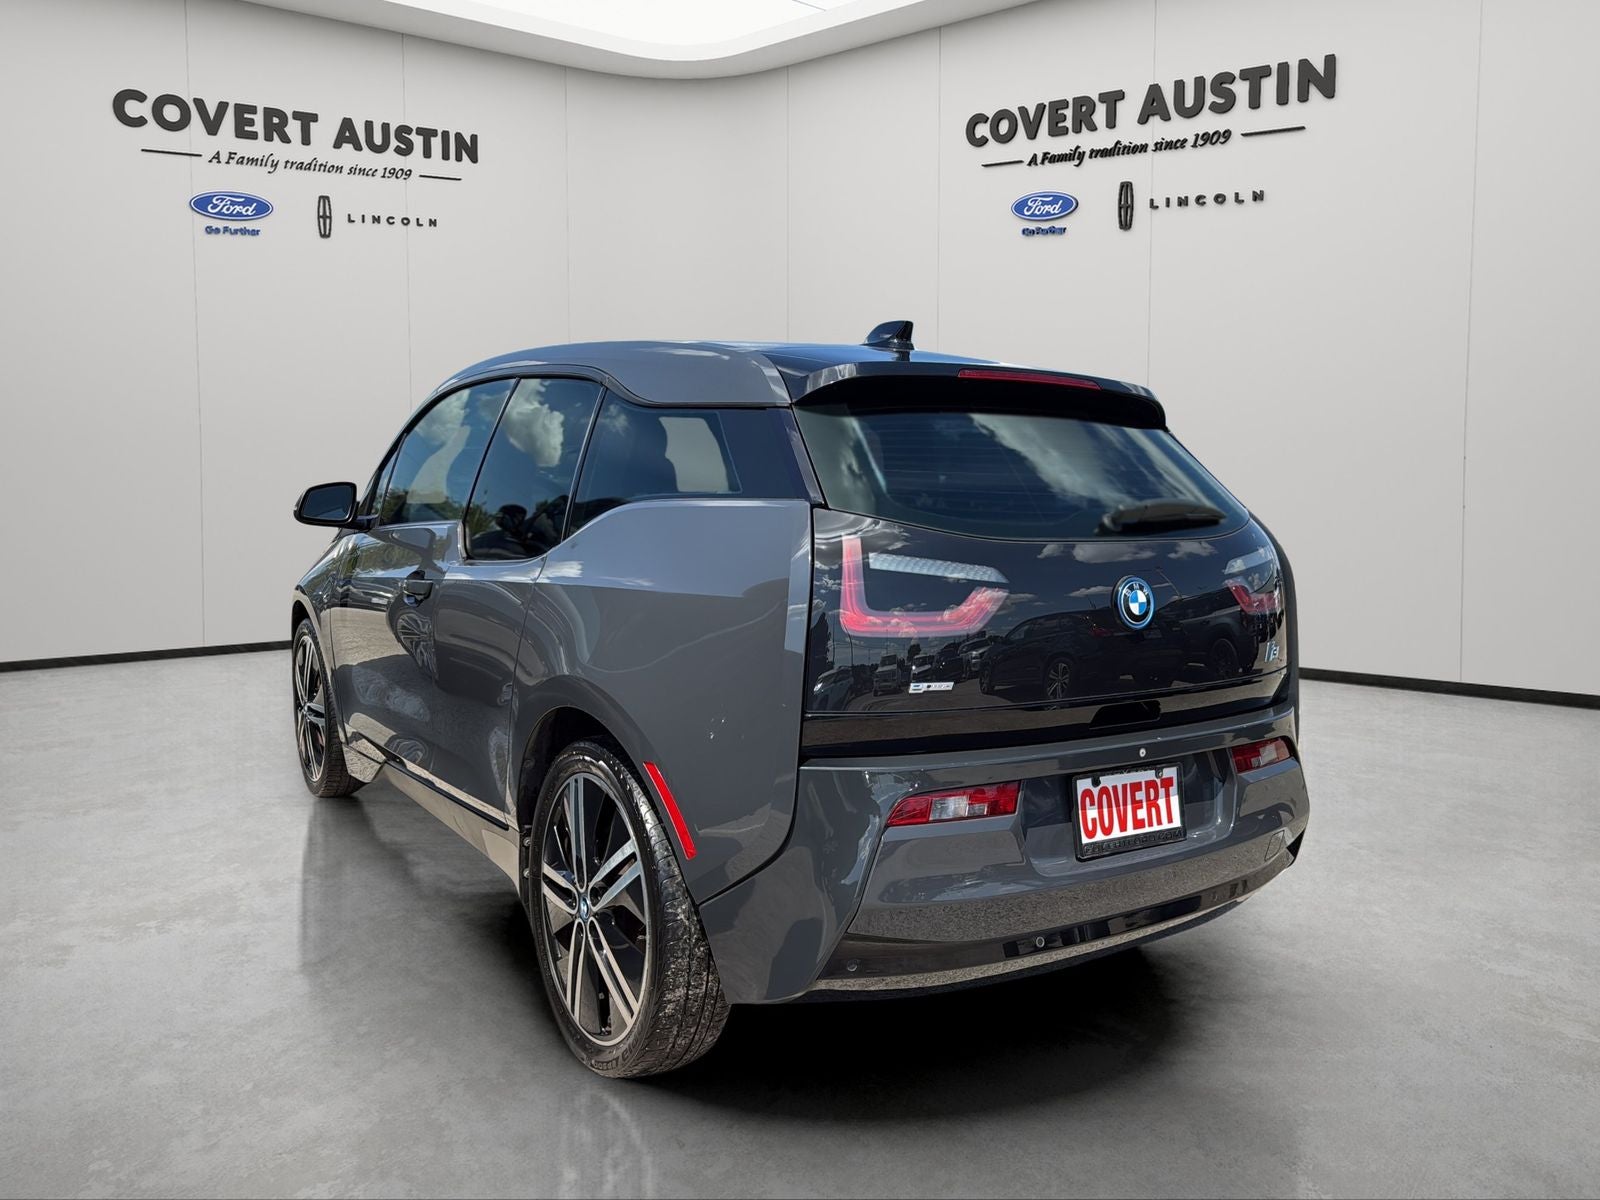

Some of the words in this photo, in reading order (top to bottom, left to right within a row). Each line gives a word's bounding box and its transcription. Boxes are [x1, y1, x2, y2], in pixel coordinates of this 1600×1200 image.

[965, 89, 1126, 148] COVERT
[1136, 53, 1337, 125] AUSTIN
[112, 88, 319, 147] COVERT
[332, 117, 479, 164] AUSTIN
[1026, 153, 1039, 167] A
[1039, 145, 1087, 168] Family
[1088, 139, 1149, 160] tradition
[1151, 137, 1188, 153] since
[1190, 128, 1232, 148] 1909
[208, 150, 222, 164] A
[224, 151, 280, 174] Family
[283, 157, 344, 175] tradition
[347, 163, 378, 178] since
[380, 166, 413, 181] 1909
[207, 194, 258, 216] Ford
[1023, 196, 1064, 215] Ford
[1149, 189, 1265, 210] LINCOLN
[347, 213, 438, 227] LINCOLN
[1080, 776, 1174, 839] COVERT
